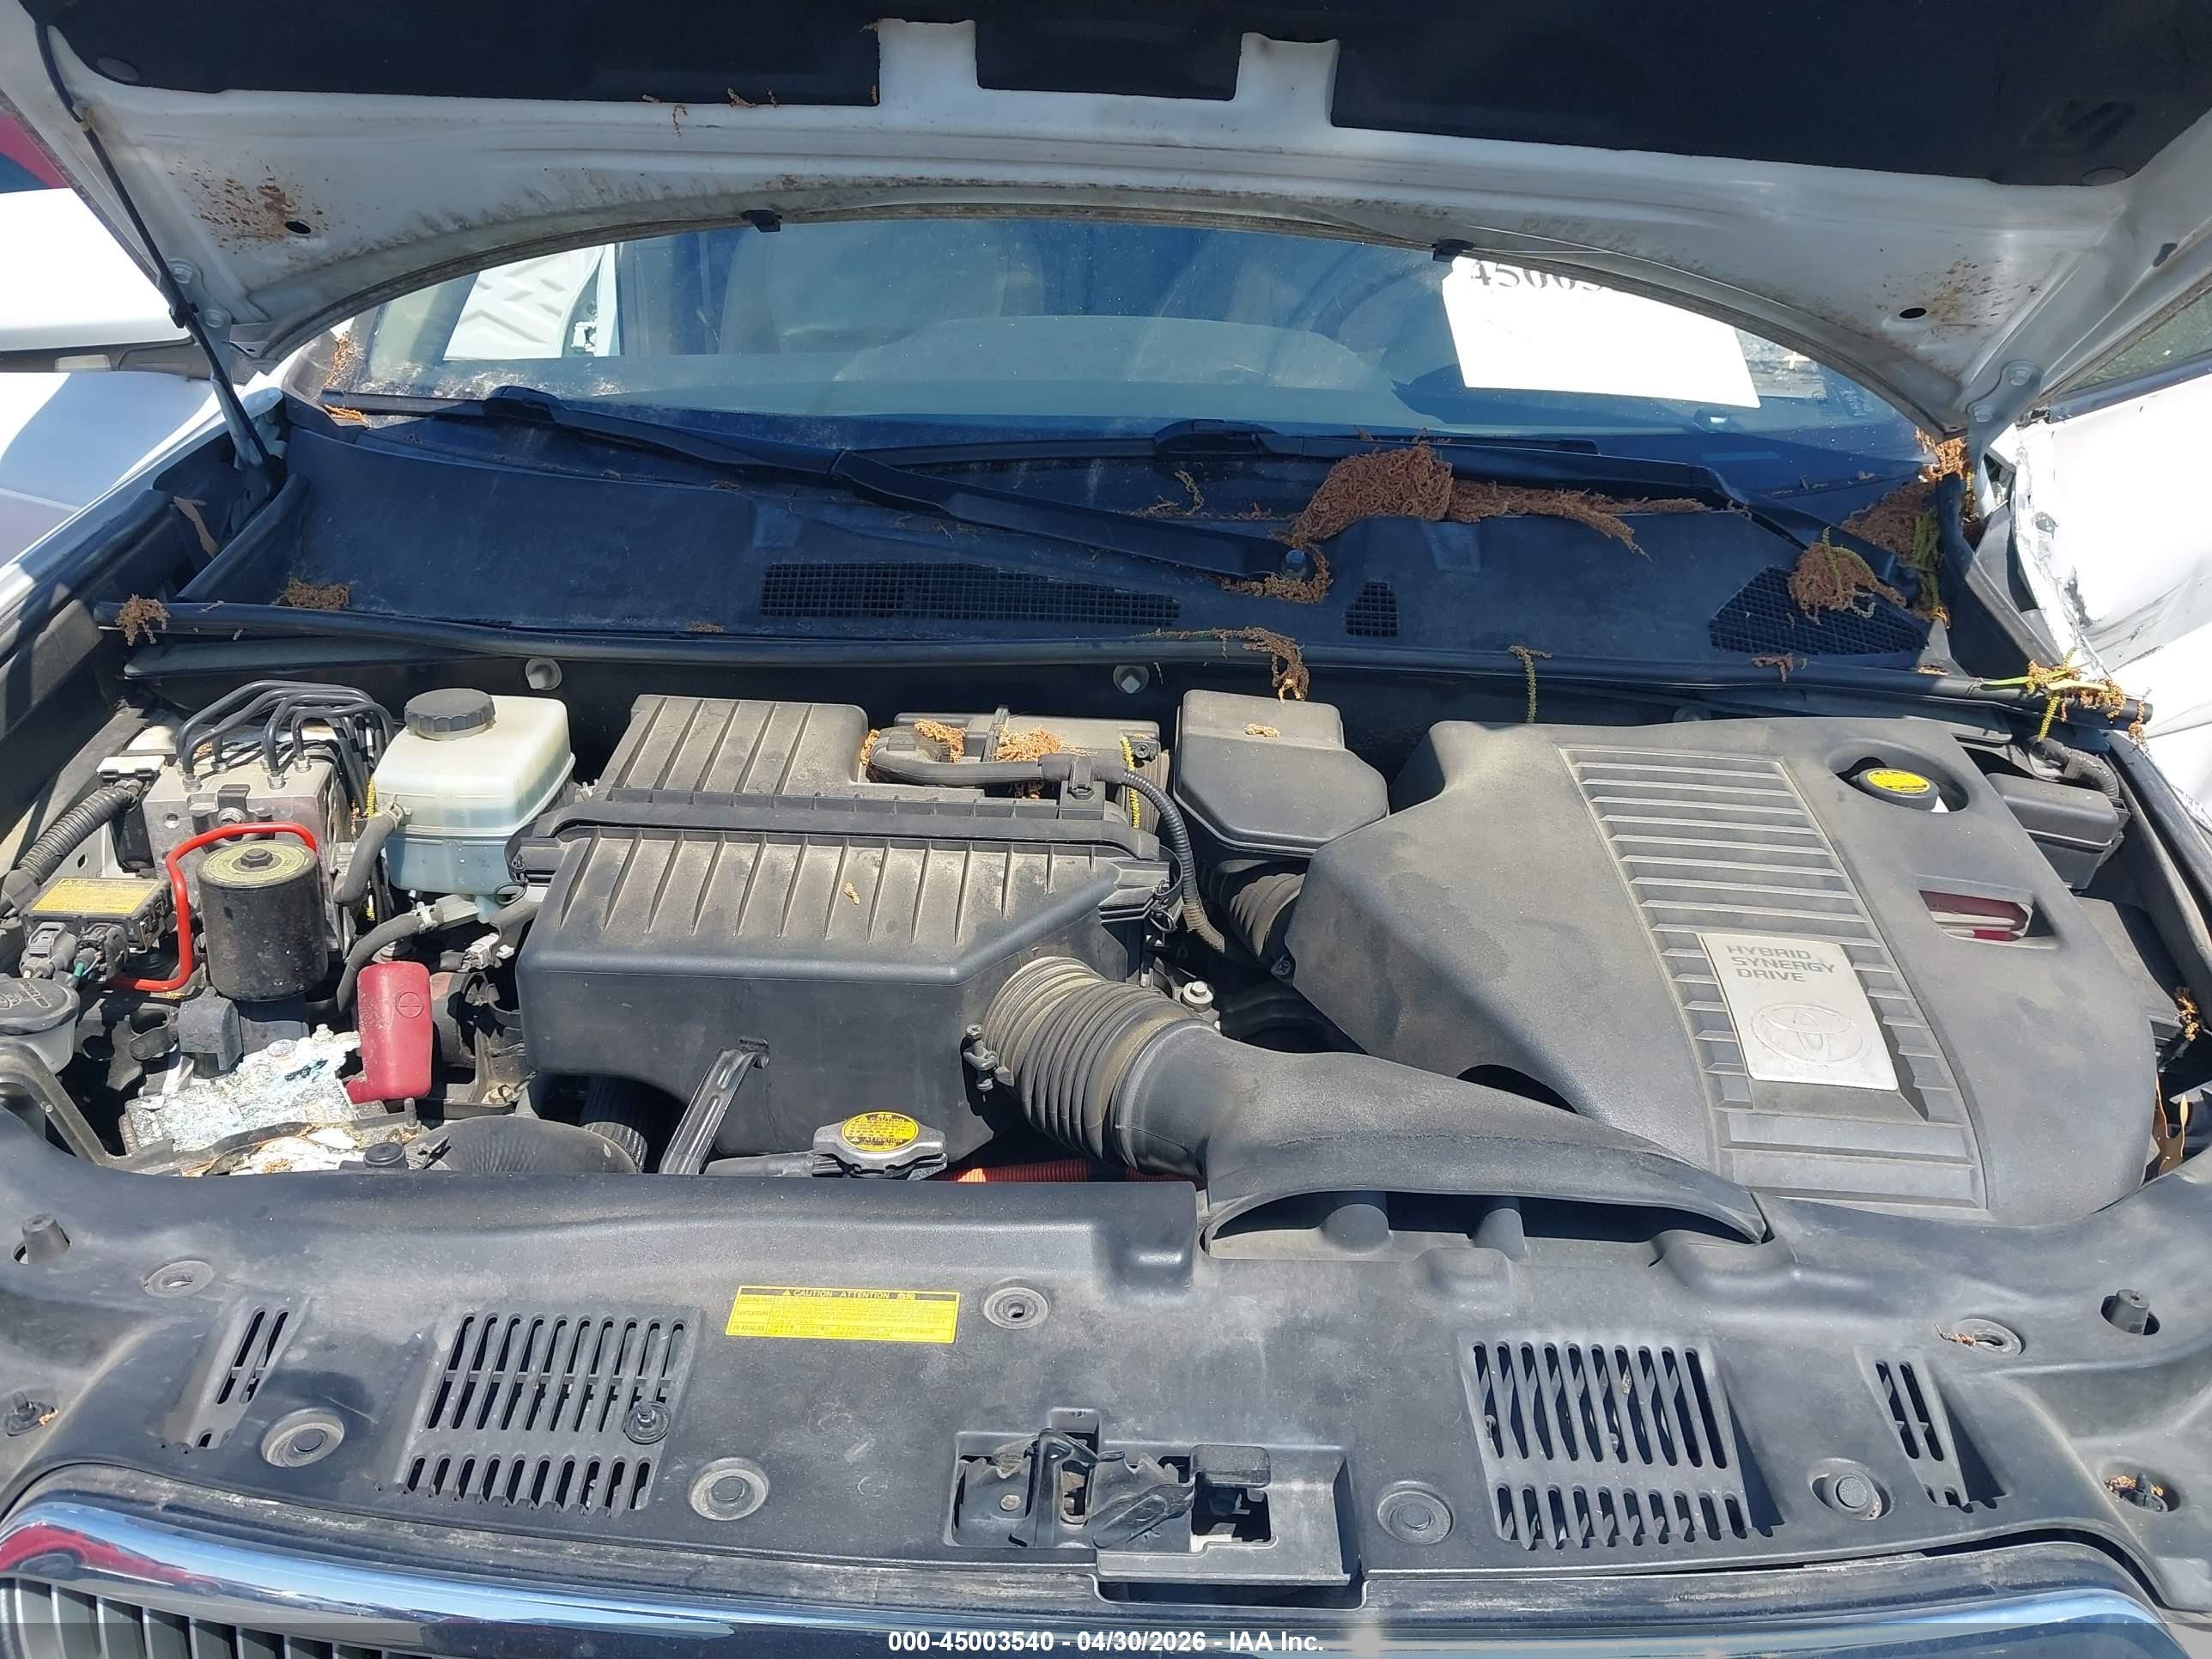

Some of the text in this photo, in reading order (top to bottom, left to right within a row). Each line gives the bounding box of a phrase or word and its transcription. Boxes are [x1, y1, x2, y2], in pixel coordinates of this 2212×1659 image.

[1726, 945, 1812, 960] HYBRID
[1731, 956, 1835, 974] SYNERGY
[1736, 968, 1807, 982] DRIVE
[840, 1291, 890, 1299] ATTENTION
